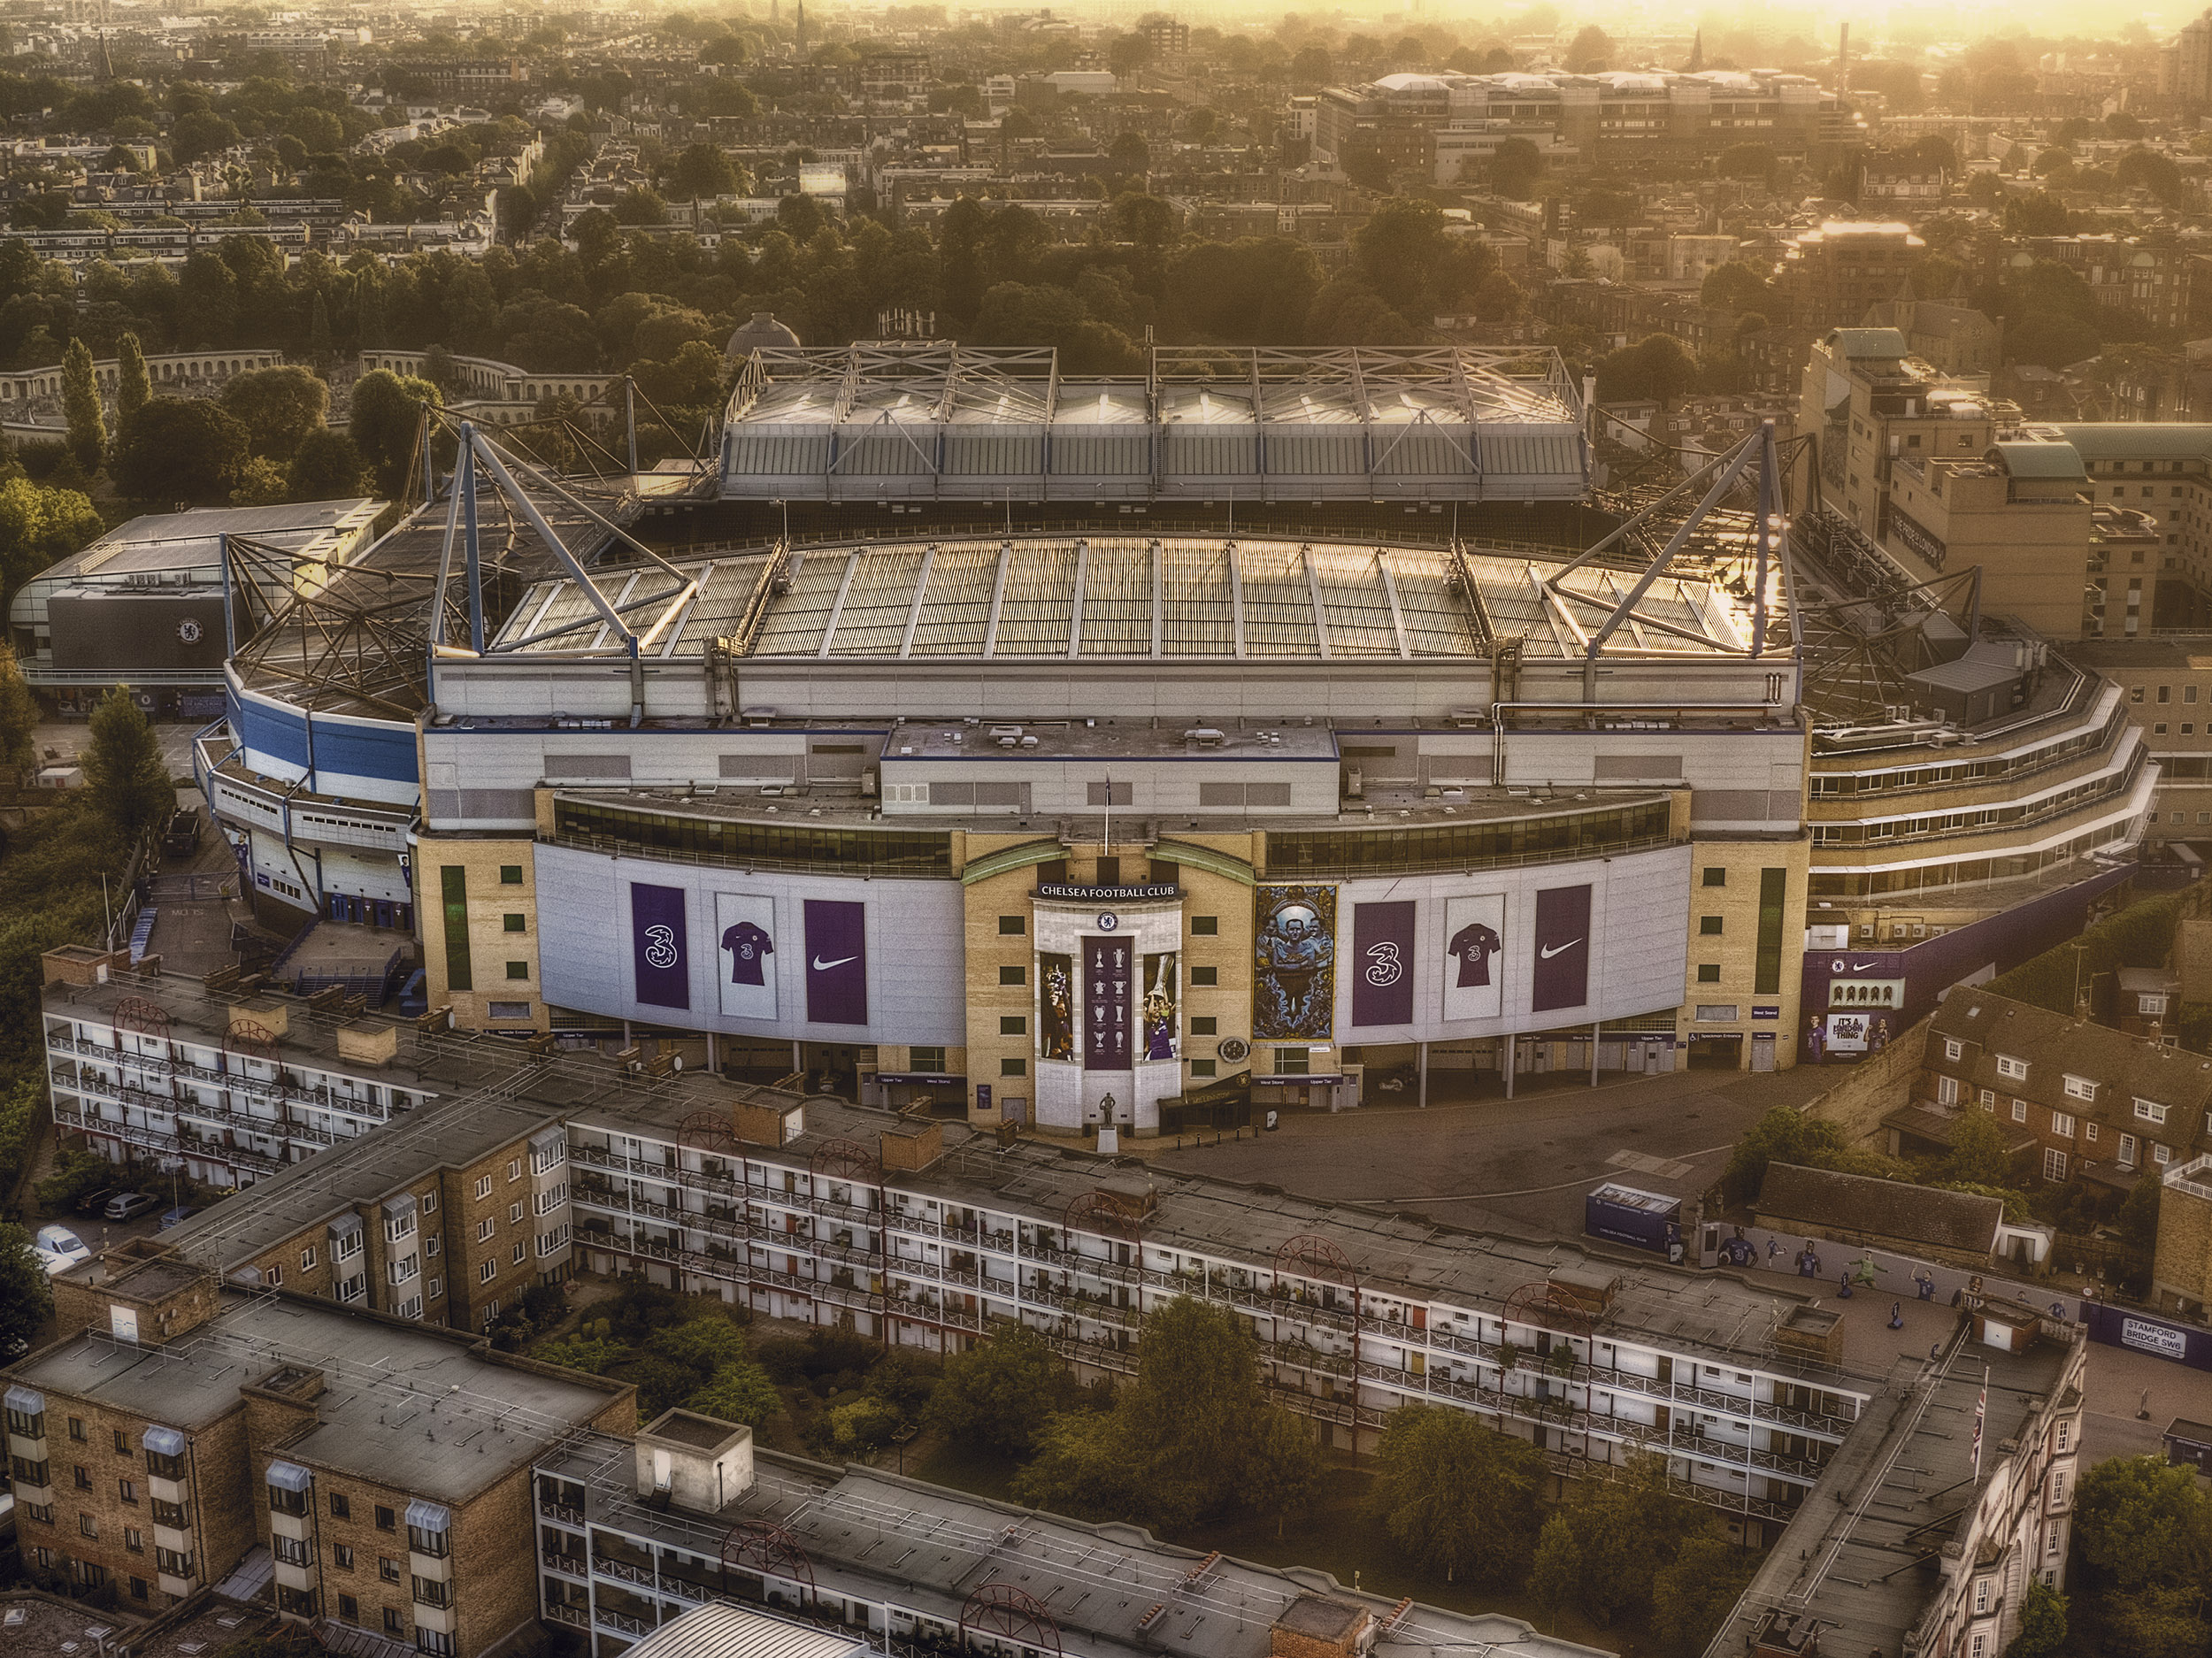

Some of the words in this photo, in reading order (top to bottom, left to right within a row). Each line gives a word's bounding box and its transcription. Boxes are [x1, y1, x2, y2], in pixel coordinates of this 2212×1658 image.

[1041, 886, 1087, 897] CHELSEA
[1089, 887, 1146, 898] FOOTBALL
[1147, 886, 1175, 897] CLUB
[644, 925, 678, 969] 3
[1366, 941, 1402, 986] 3
[1599, 1227, 1617, 1236] CHELSEA
[1617, 1232, 1636, 1241] FOOTBALL
[2126, 1329, 2160, 1345] BRIDGE
[2161, 1339, 2181, 1350] SW6
[2127, 1320, 2177, 1339] STAMFORD
